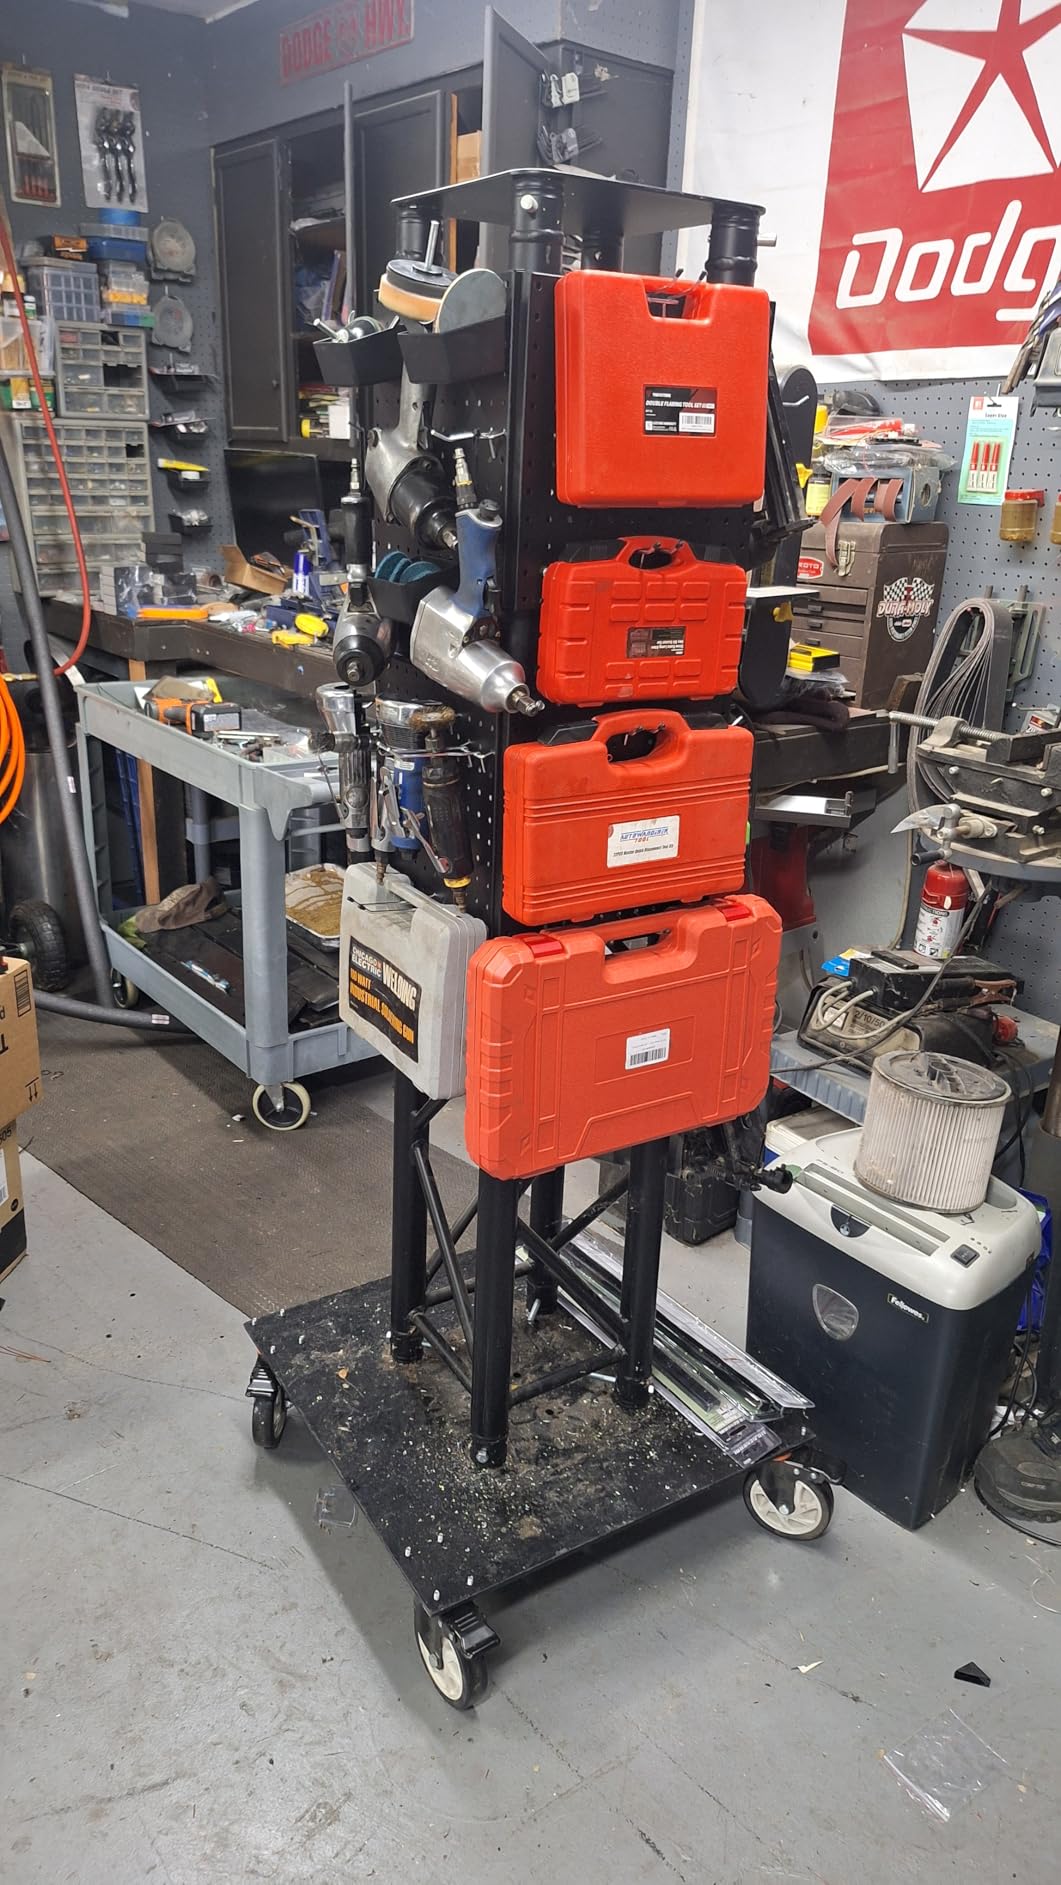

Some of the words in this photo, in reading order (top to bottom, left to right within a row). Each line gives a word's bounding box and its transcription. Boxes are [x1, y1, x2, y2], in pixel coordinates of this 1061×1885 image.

[282, 16, 333, 78] DODGE
[876, 599, 934, 618] DURA-MOLY
[351, 954, 382, 977] ELECTRIC
[352, 946, 377, 967] CHICAGO
[382, 961, 417, 1011] WELDING
